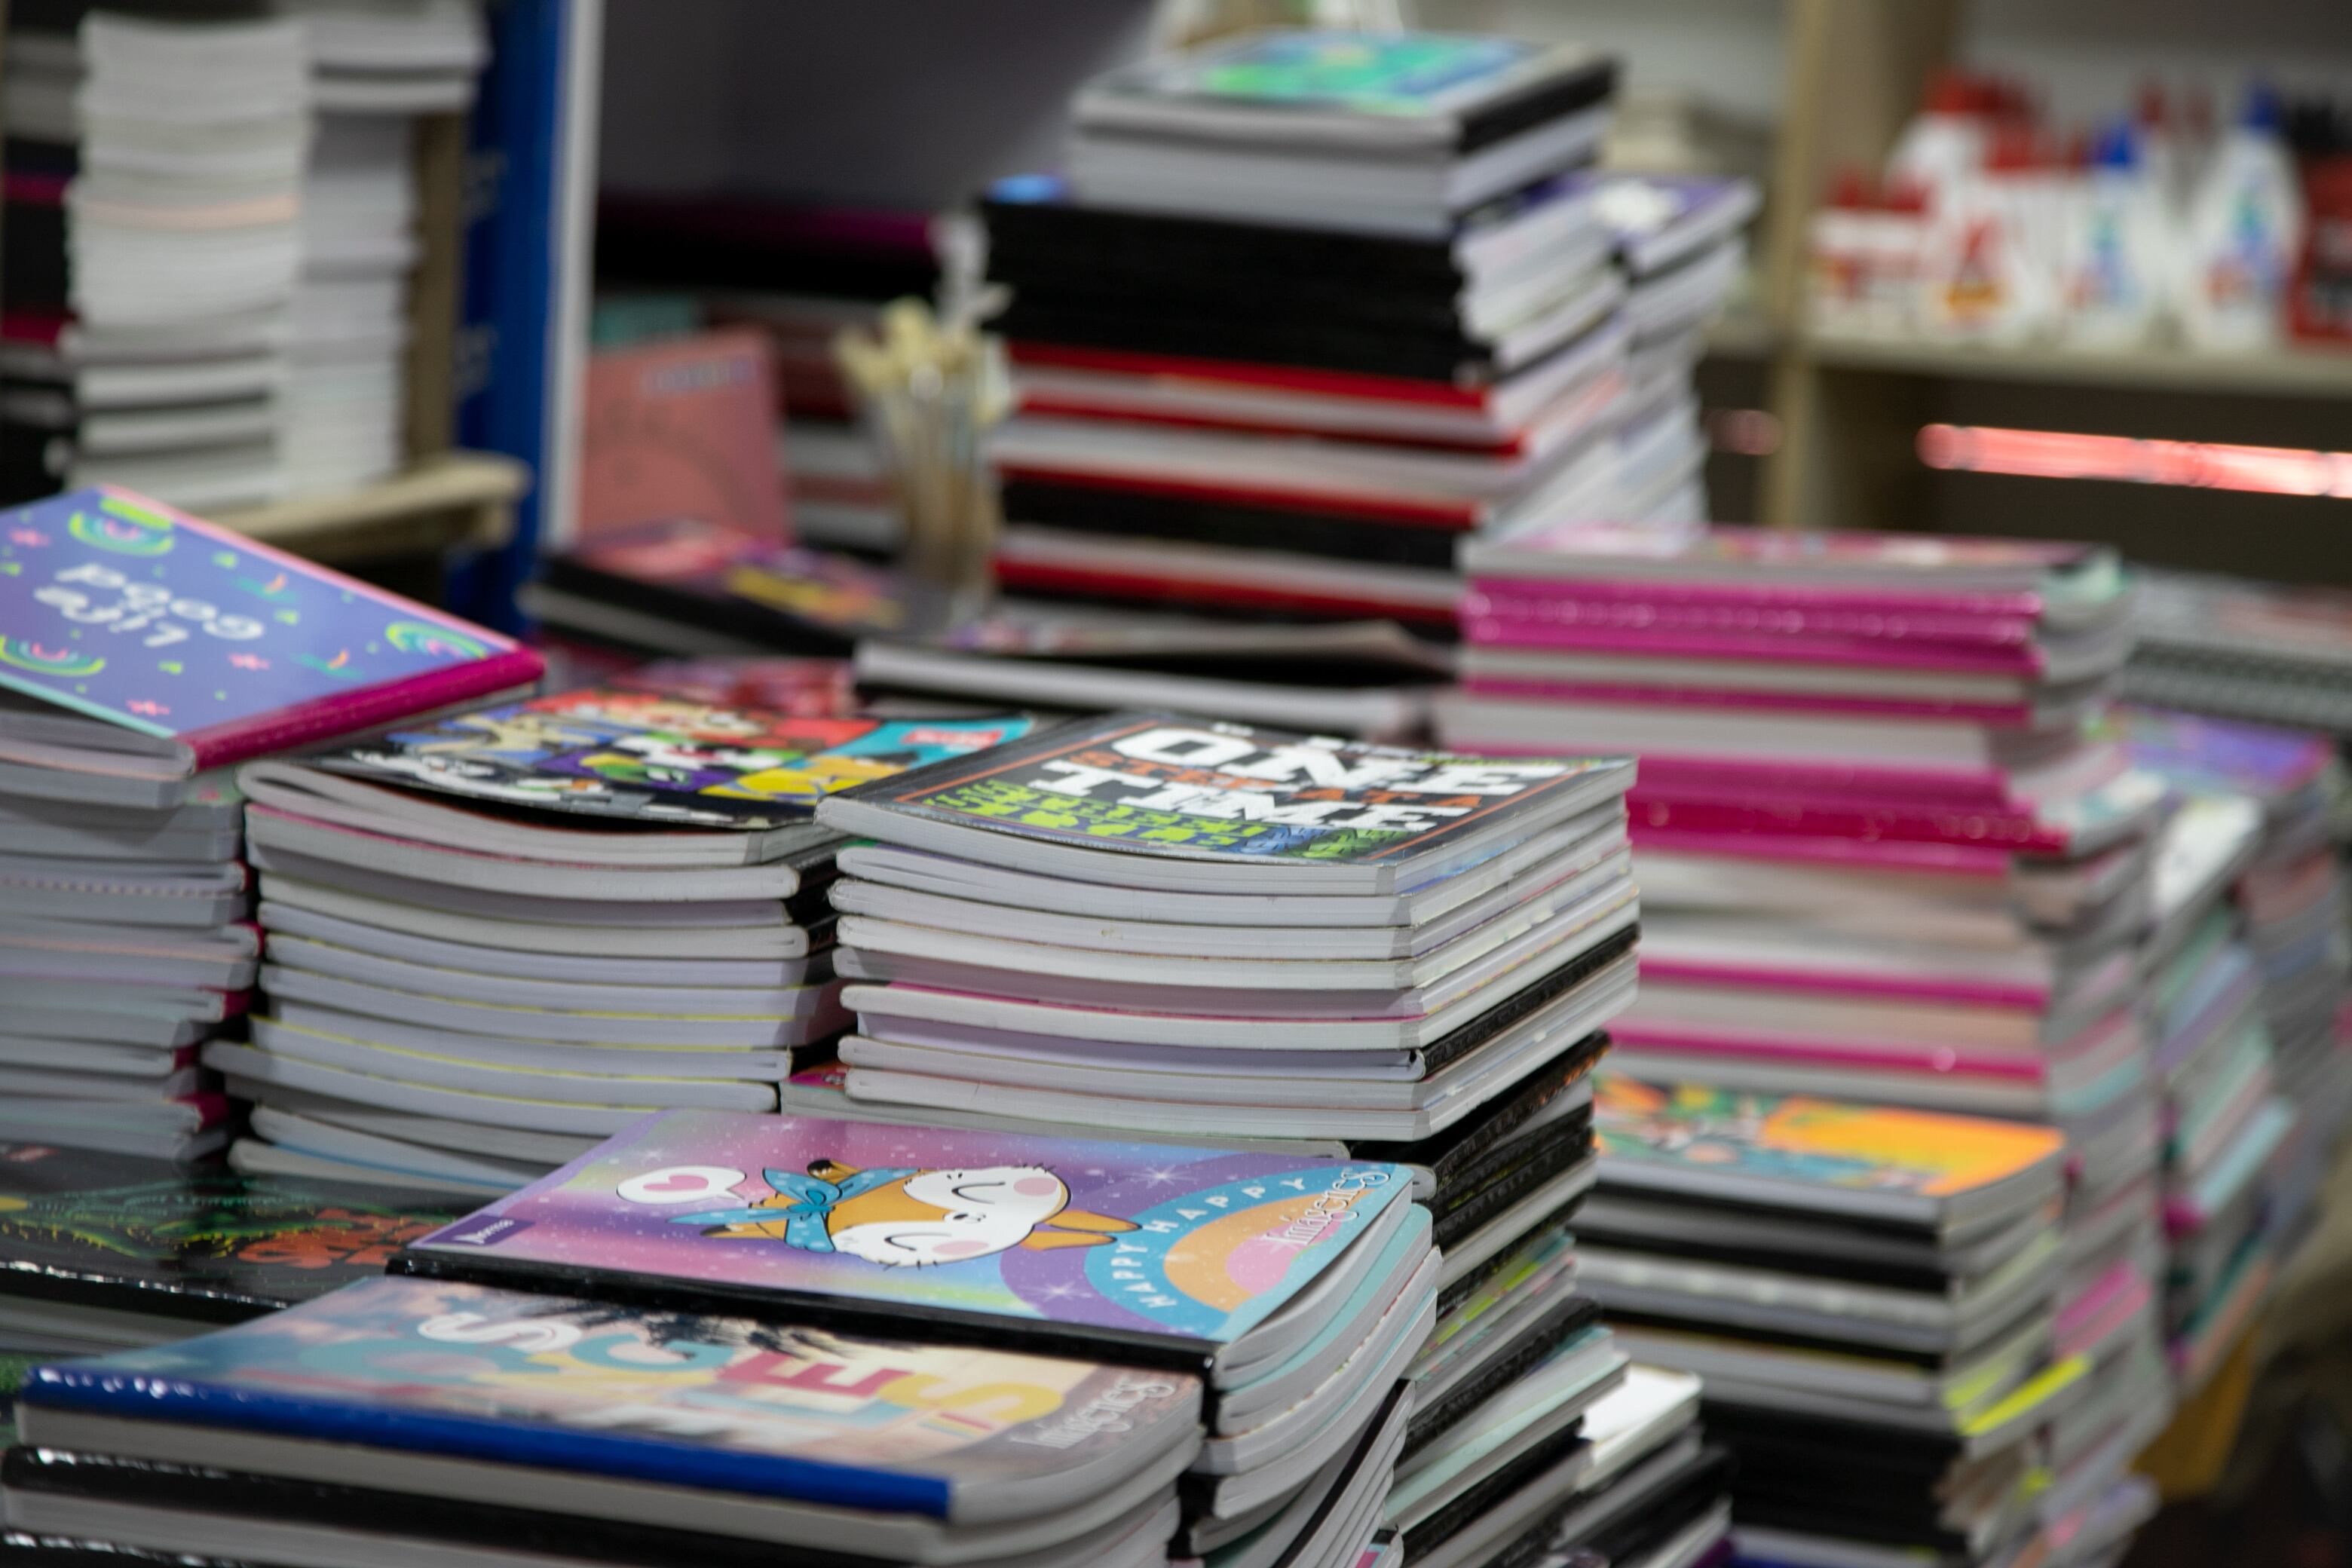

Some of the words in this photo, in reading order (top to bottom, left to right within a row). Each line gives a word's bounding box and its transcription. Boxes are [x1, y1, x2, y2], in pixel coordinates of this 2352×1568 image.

[1027, 758, 1475, 832] TIME
[1111, 727, 1570, 797] ONE
[1141, 1177, 1306, 1233] HAPPY
[1110, 1242, 1178, 1309] HAPPY
